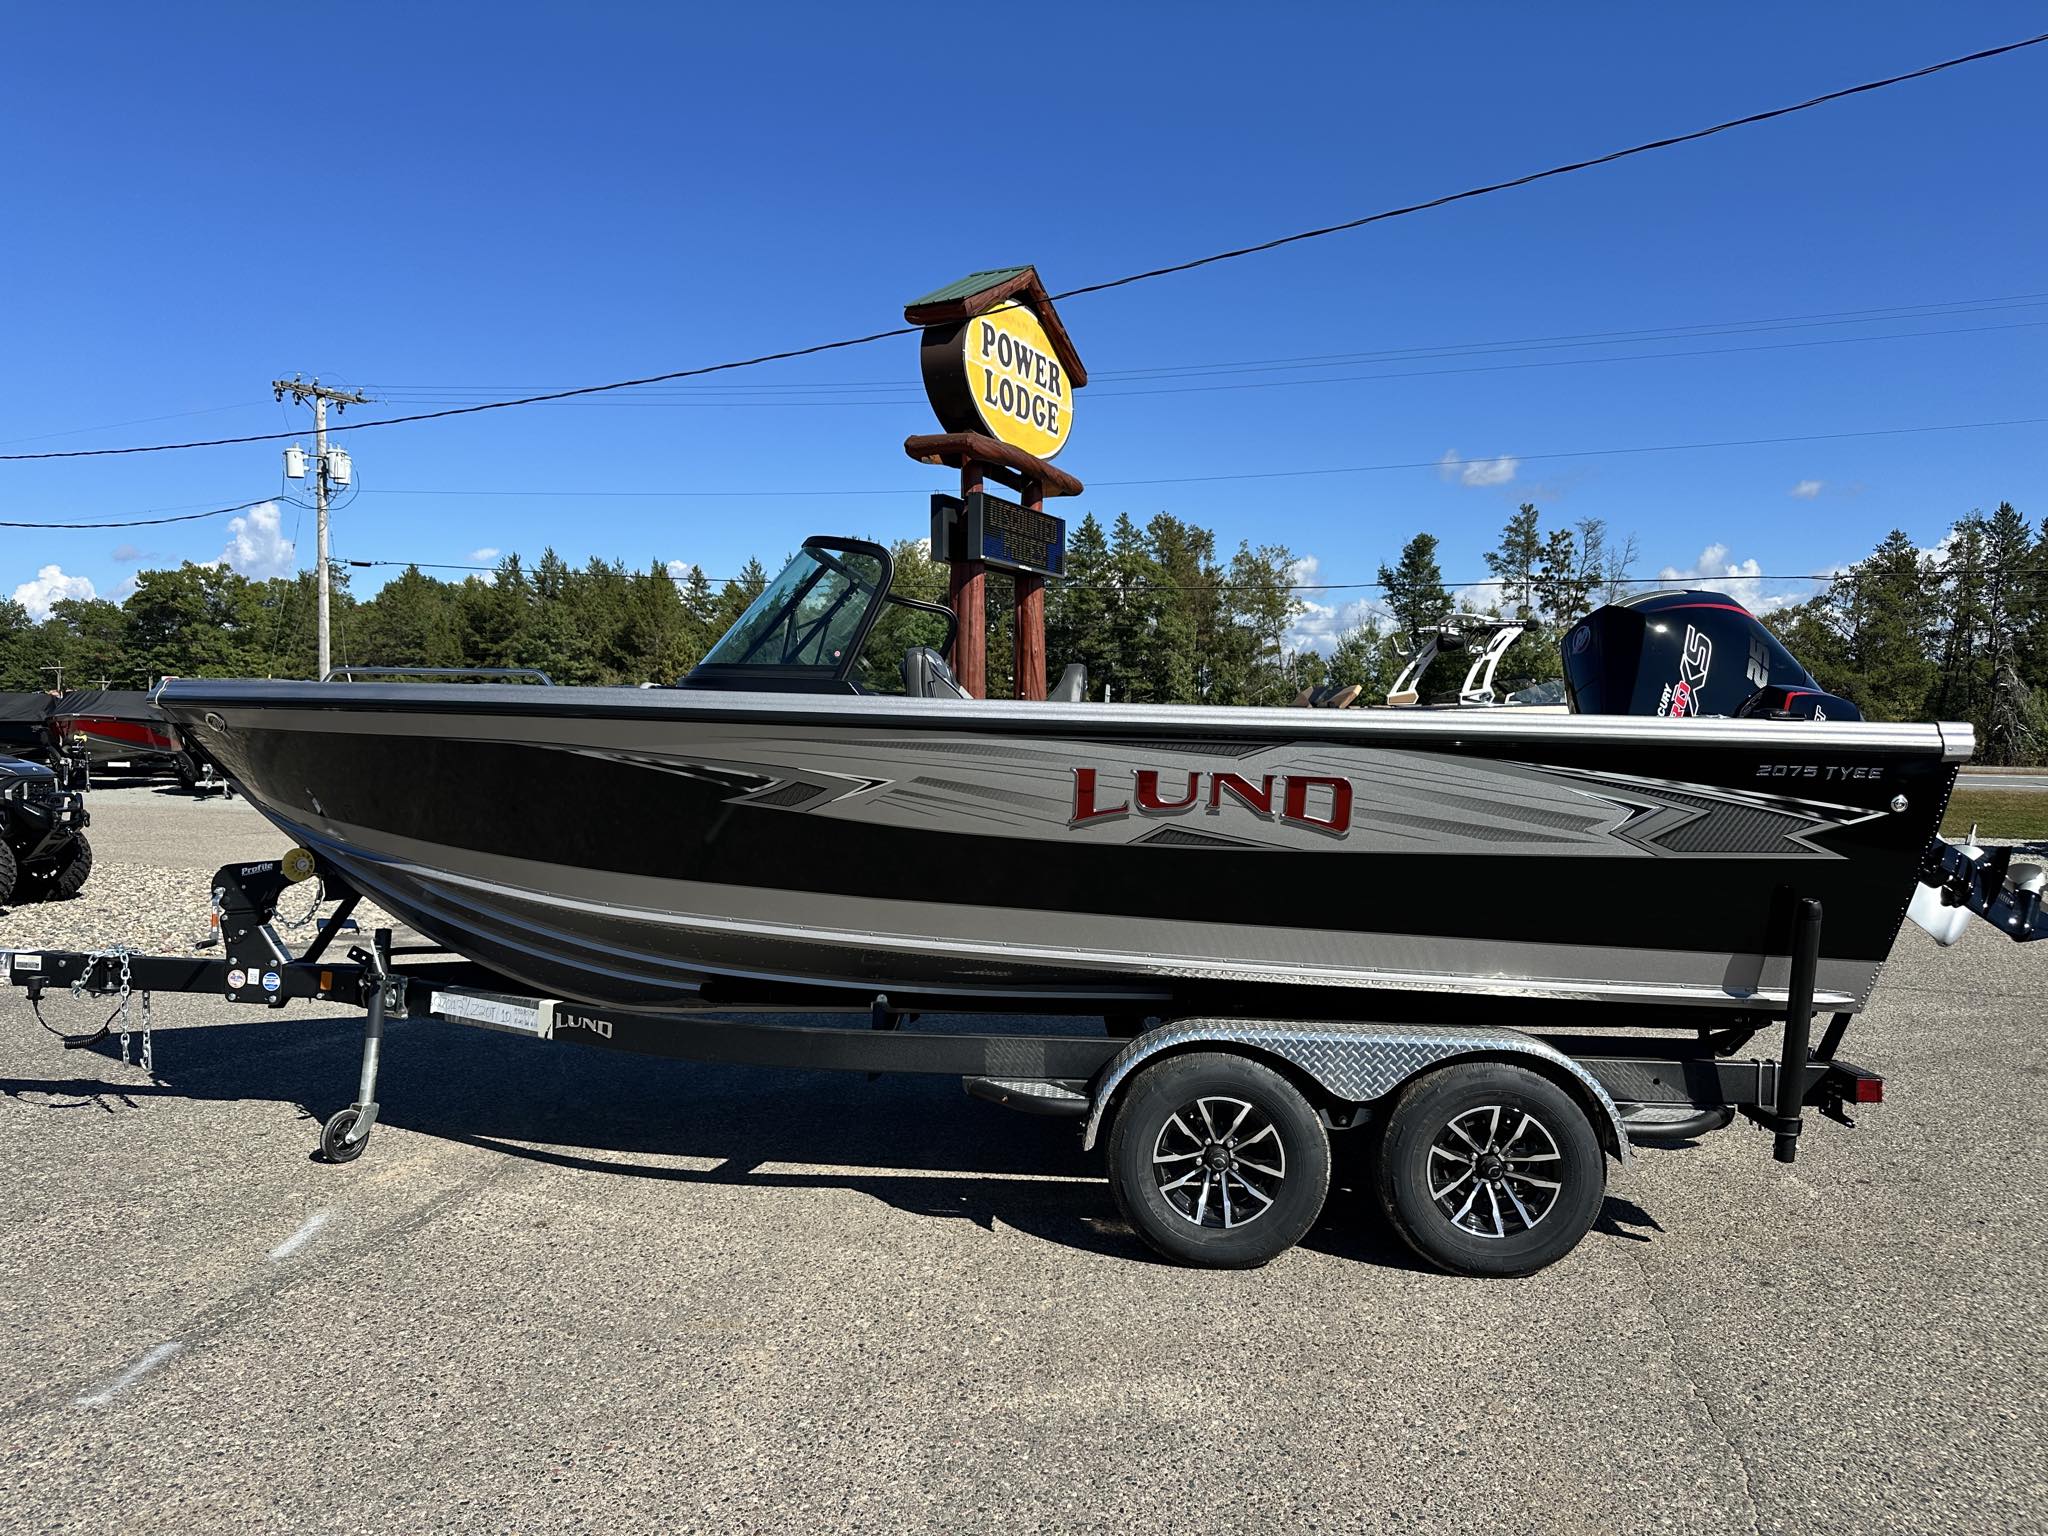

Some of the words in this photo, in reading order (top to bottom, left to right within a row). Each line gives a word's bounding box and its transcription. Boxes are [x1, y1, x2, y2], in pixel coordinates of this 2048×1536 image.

[981, 321, 1062, 398] POWER
[984, 368, 1060, 436] LODGE
[990, 500, 1057, 544] DISCOUNTED
[1755, 764, 1819, 778] 2075
[1825, 766, 1885, 781] TYEE
[1067, 767, 1354, 839] LUND
[240, 862, 274, 876] Profile
[555, 1012, 613, 1040] LUND
